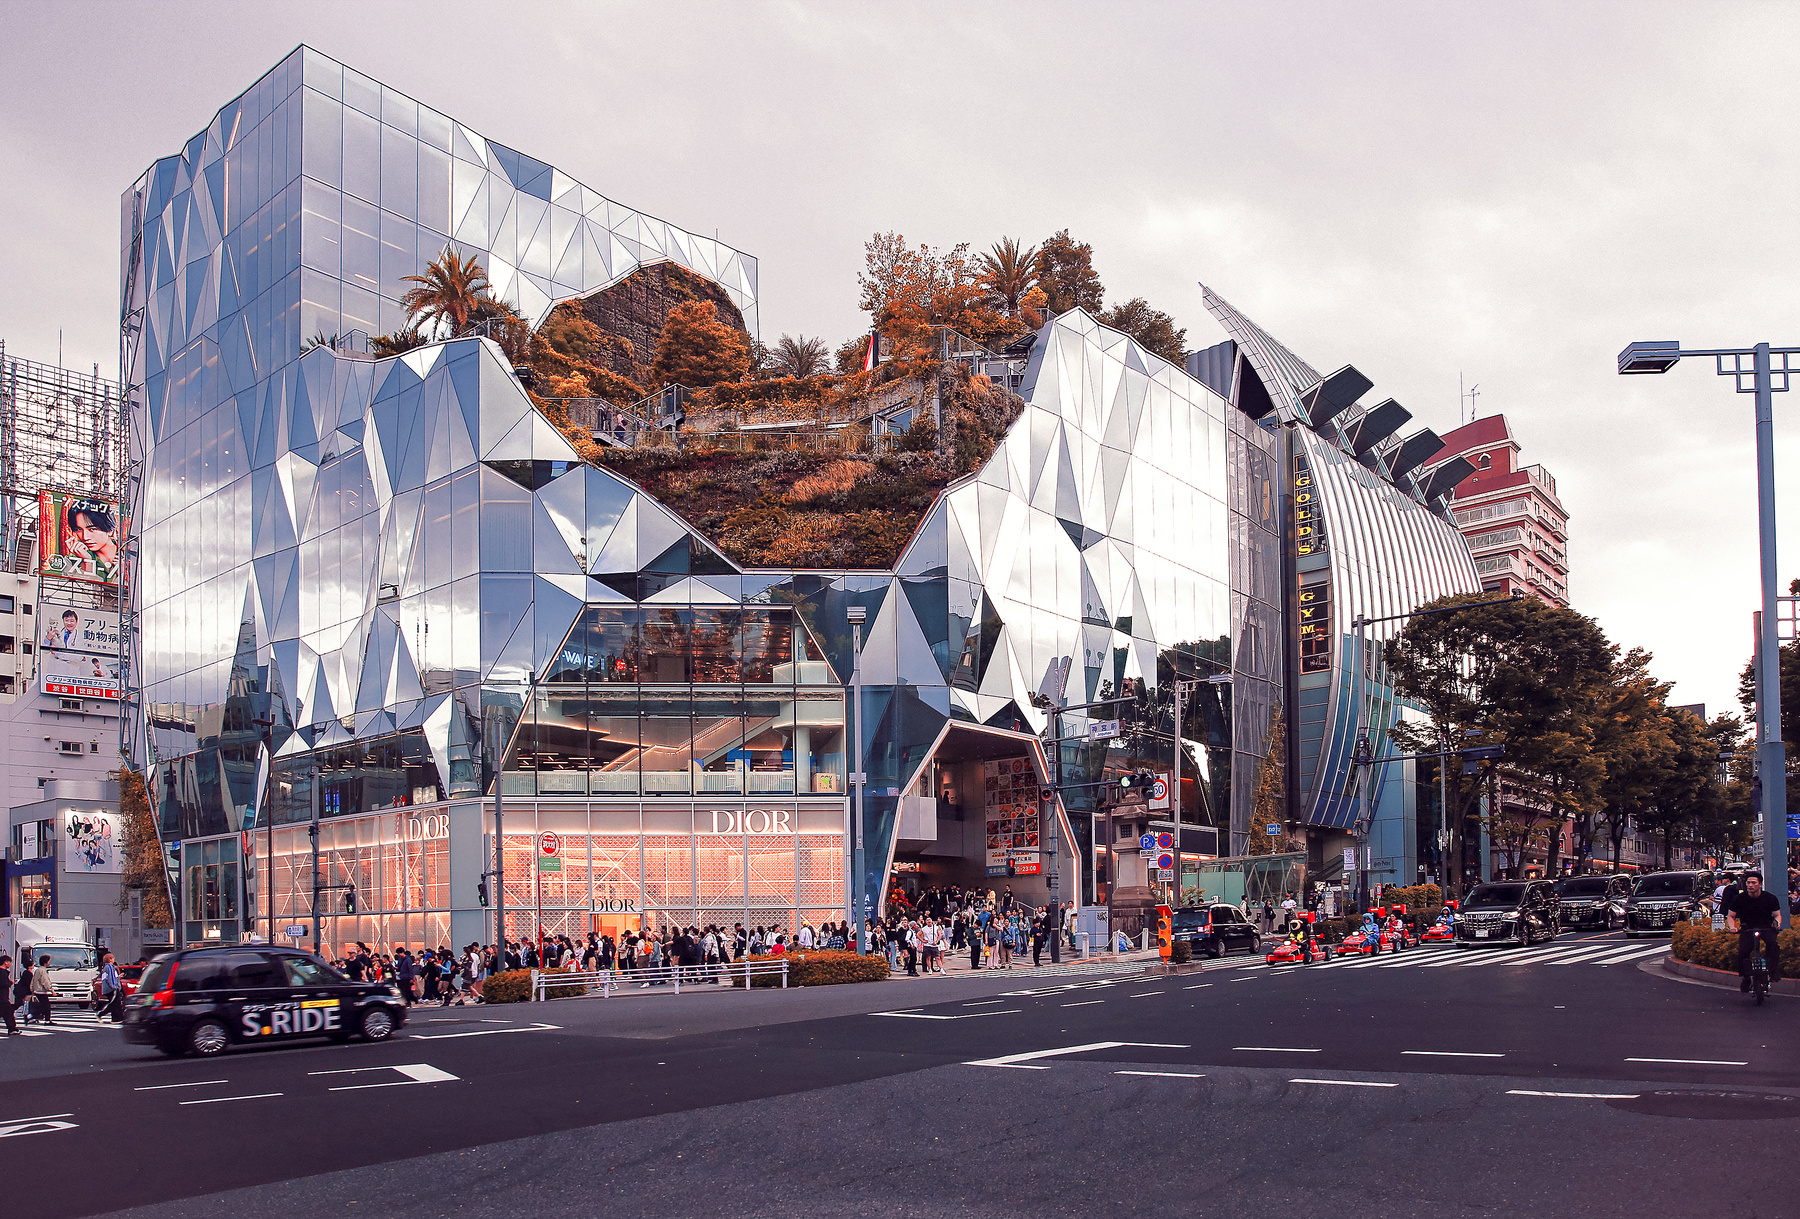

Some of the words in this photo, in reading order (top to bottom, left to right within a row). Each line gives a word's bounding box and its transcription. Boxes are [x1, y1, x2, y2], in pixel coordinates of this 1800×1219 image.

[68, 556, 119, 578] スコーン
[1300, 592, 1316, 635] GYM
[556, 650, 594, 669] -WAE
[409, 814, 449, 841] DIOR
[710, 809, 793, 834] DIOR
[591, 898, 637, 912] DIOR
